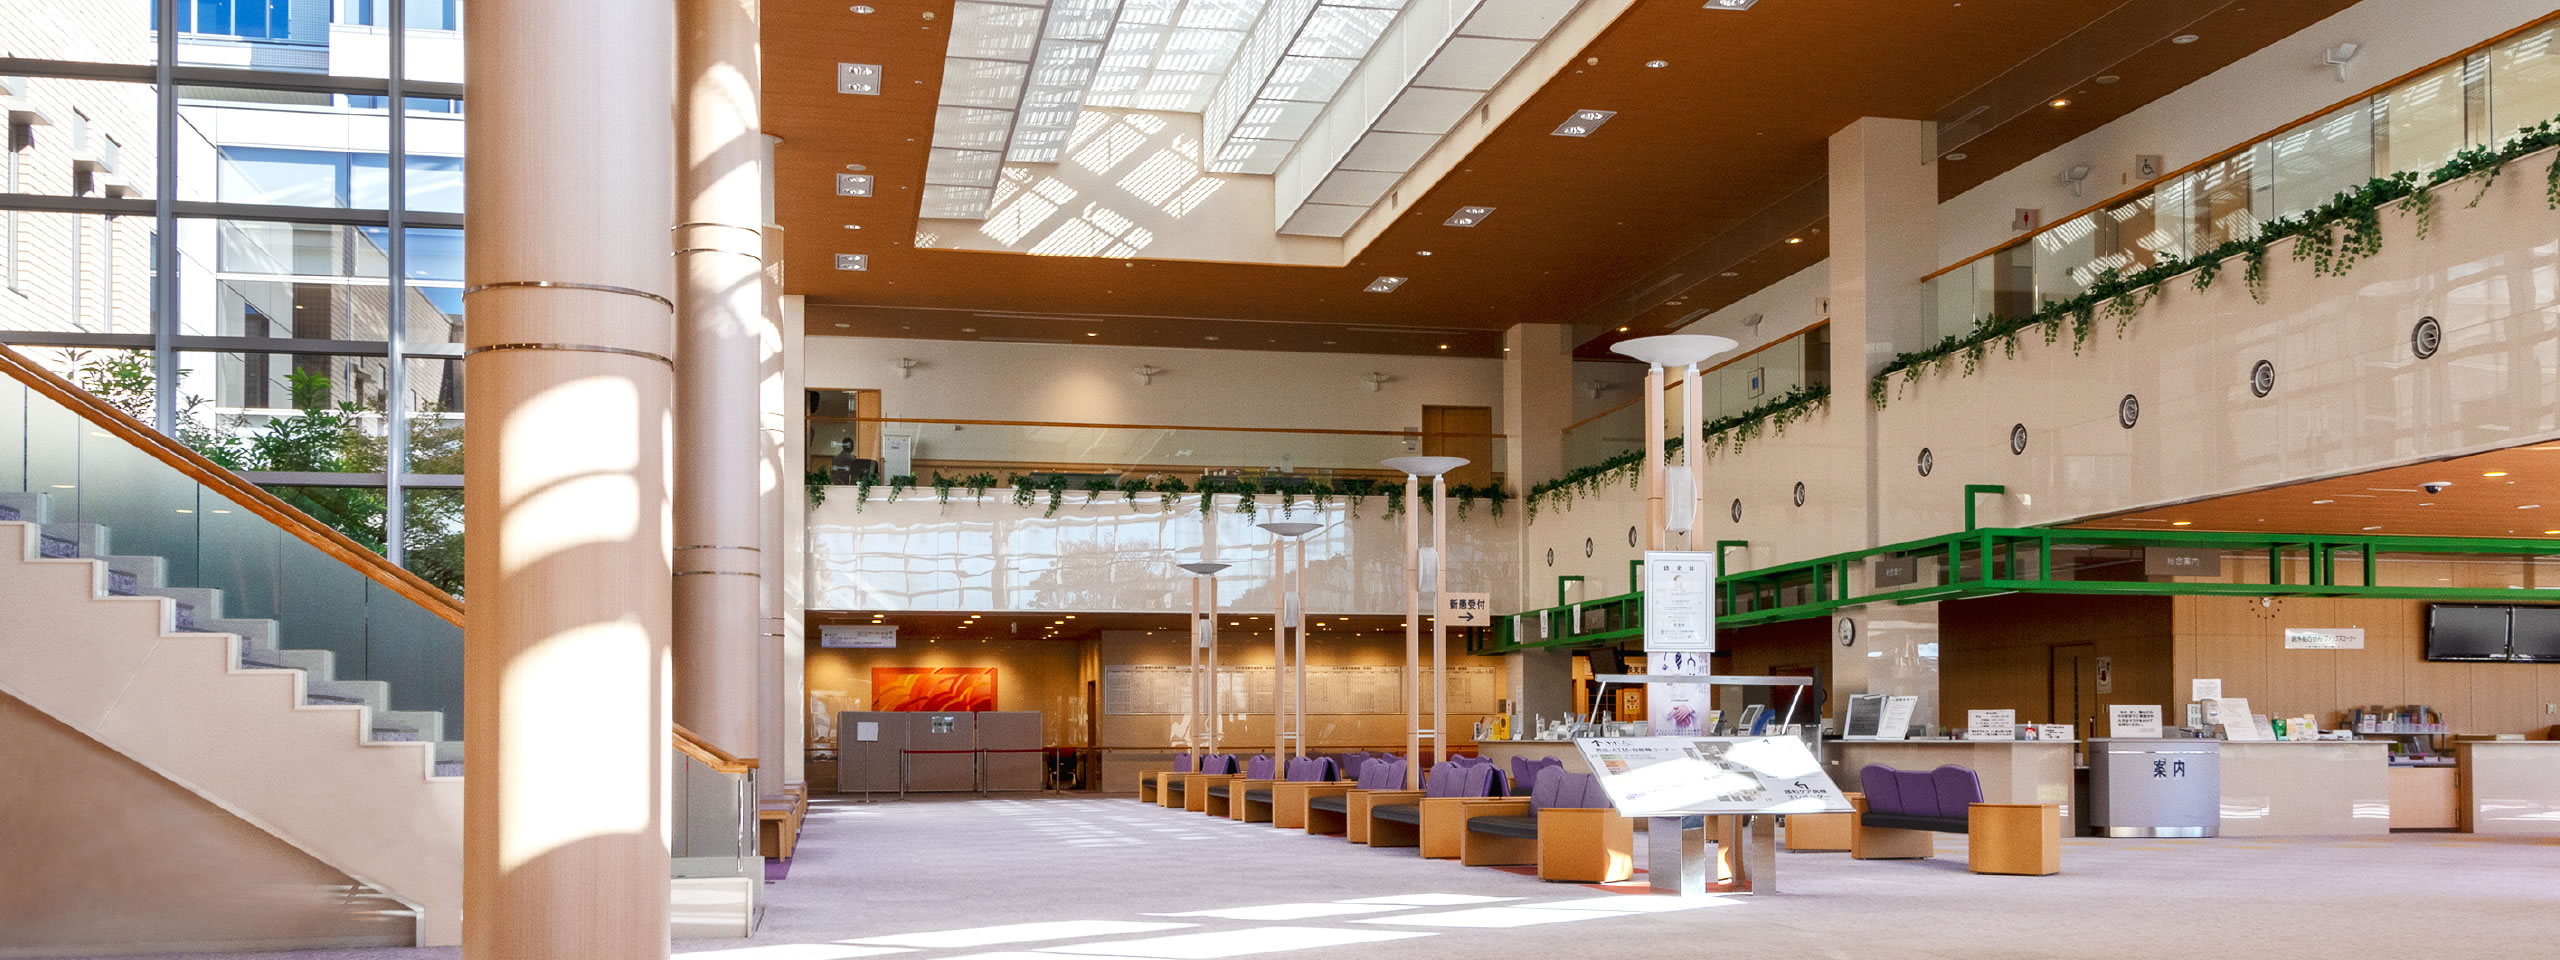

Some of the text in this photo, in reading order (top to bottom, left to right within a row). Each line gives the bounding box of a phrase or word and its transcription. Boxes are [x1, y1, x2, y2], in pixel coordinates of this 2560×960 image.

[2167, 556, 2201, 566] 総合案内
[1449, 599, 1485, 610] 新患受付
[2153, 759, 2185, 778] 案内
